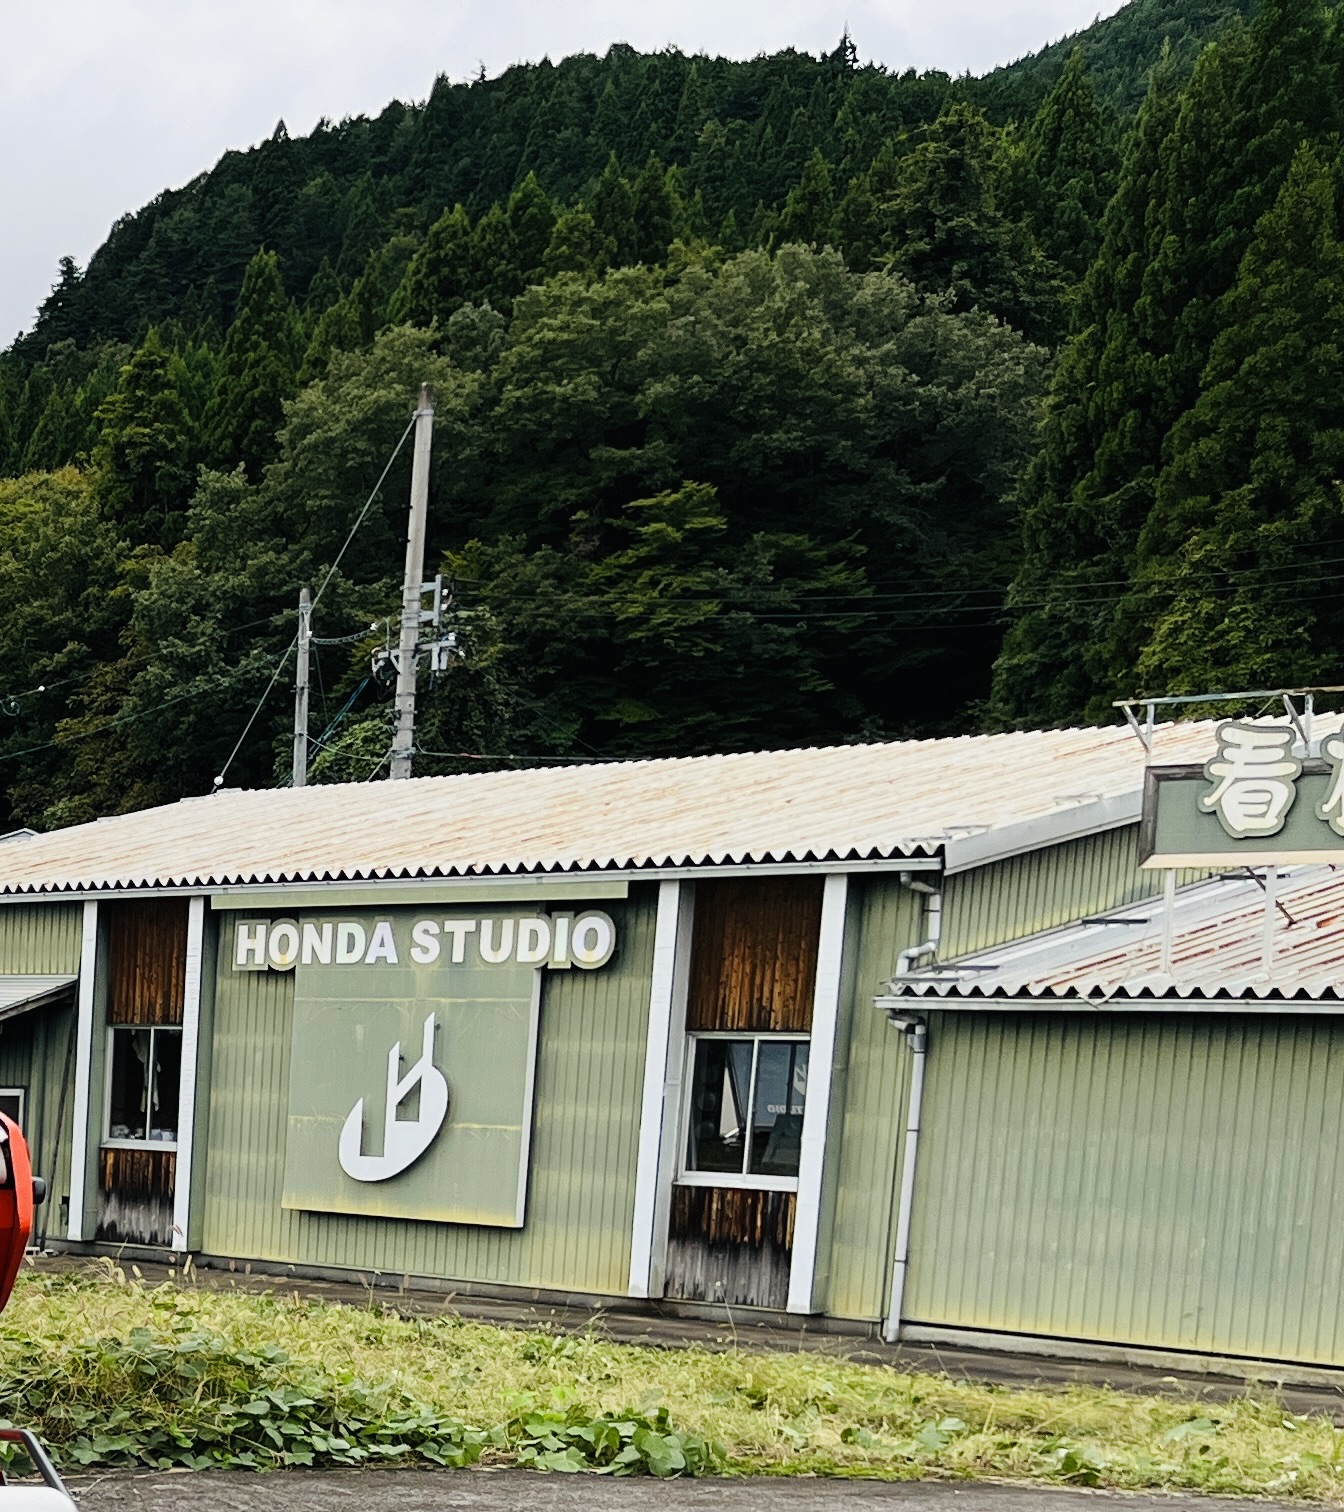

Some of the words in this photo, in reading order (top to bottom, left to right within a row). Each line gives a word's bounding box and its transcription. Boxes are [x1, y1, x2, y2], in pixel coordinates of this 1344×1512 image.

[1203, 726, 1344, 832] 看
[236, 921, 399, 965] HONDA
[410, 916, 610, 964] STUDIO
